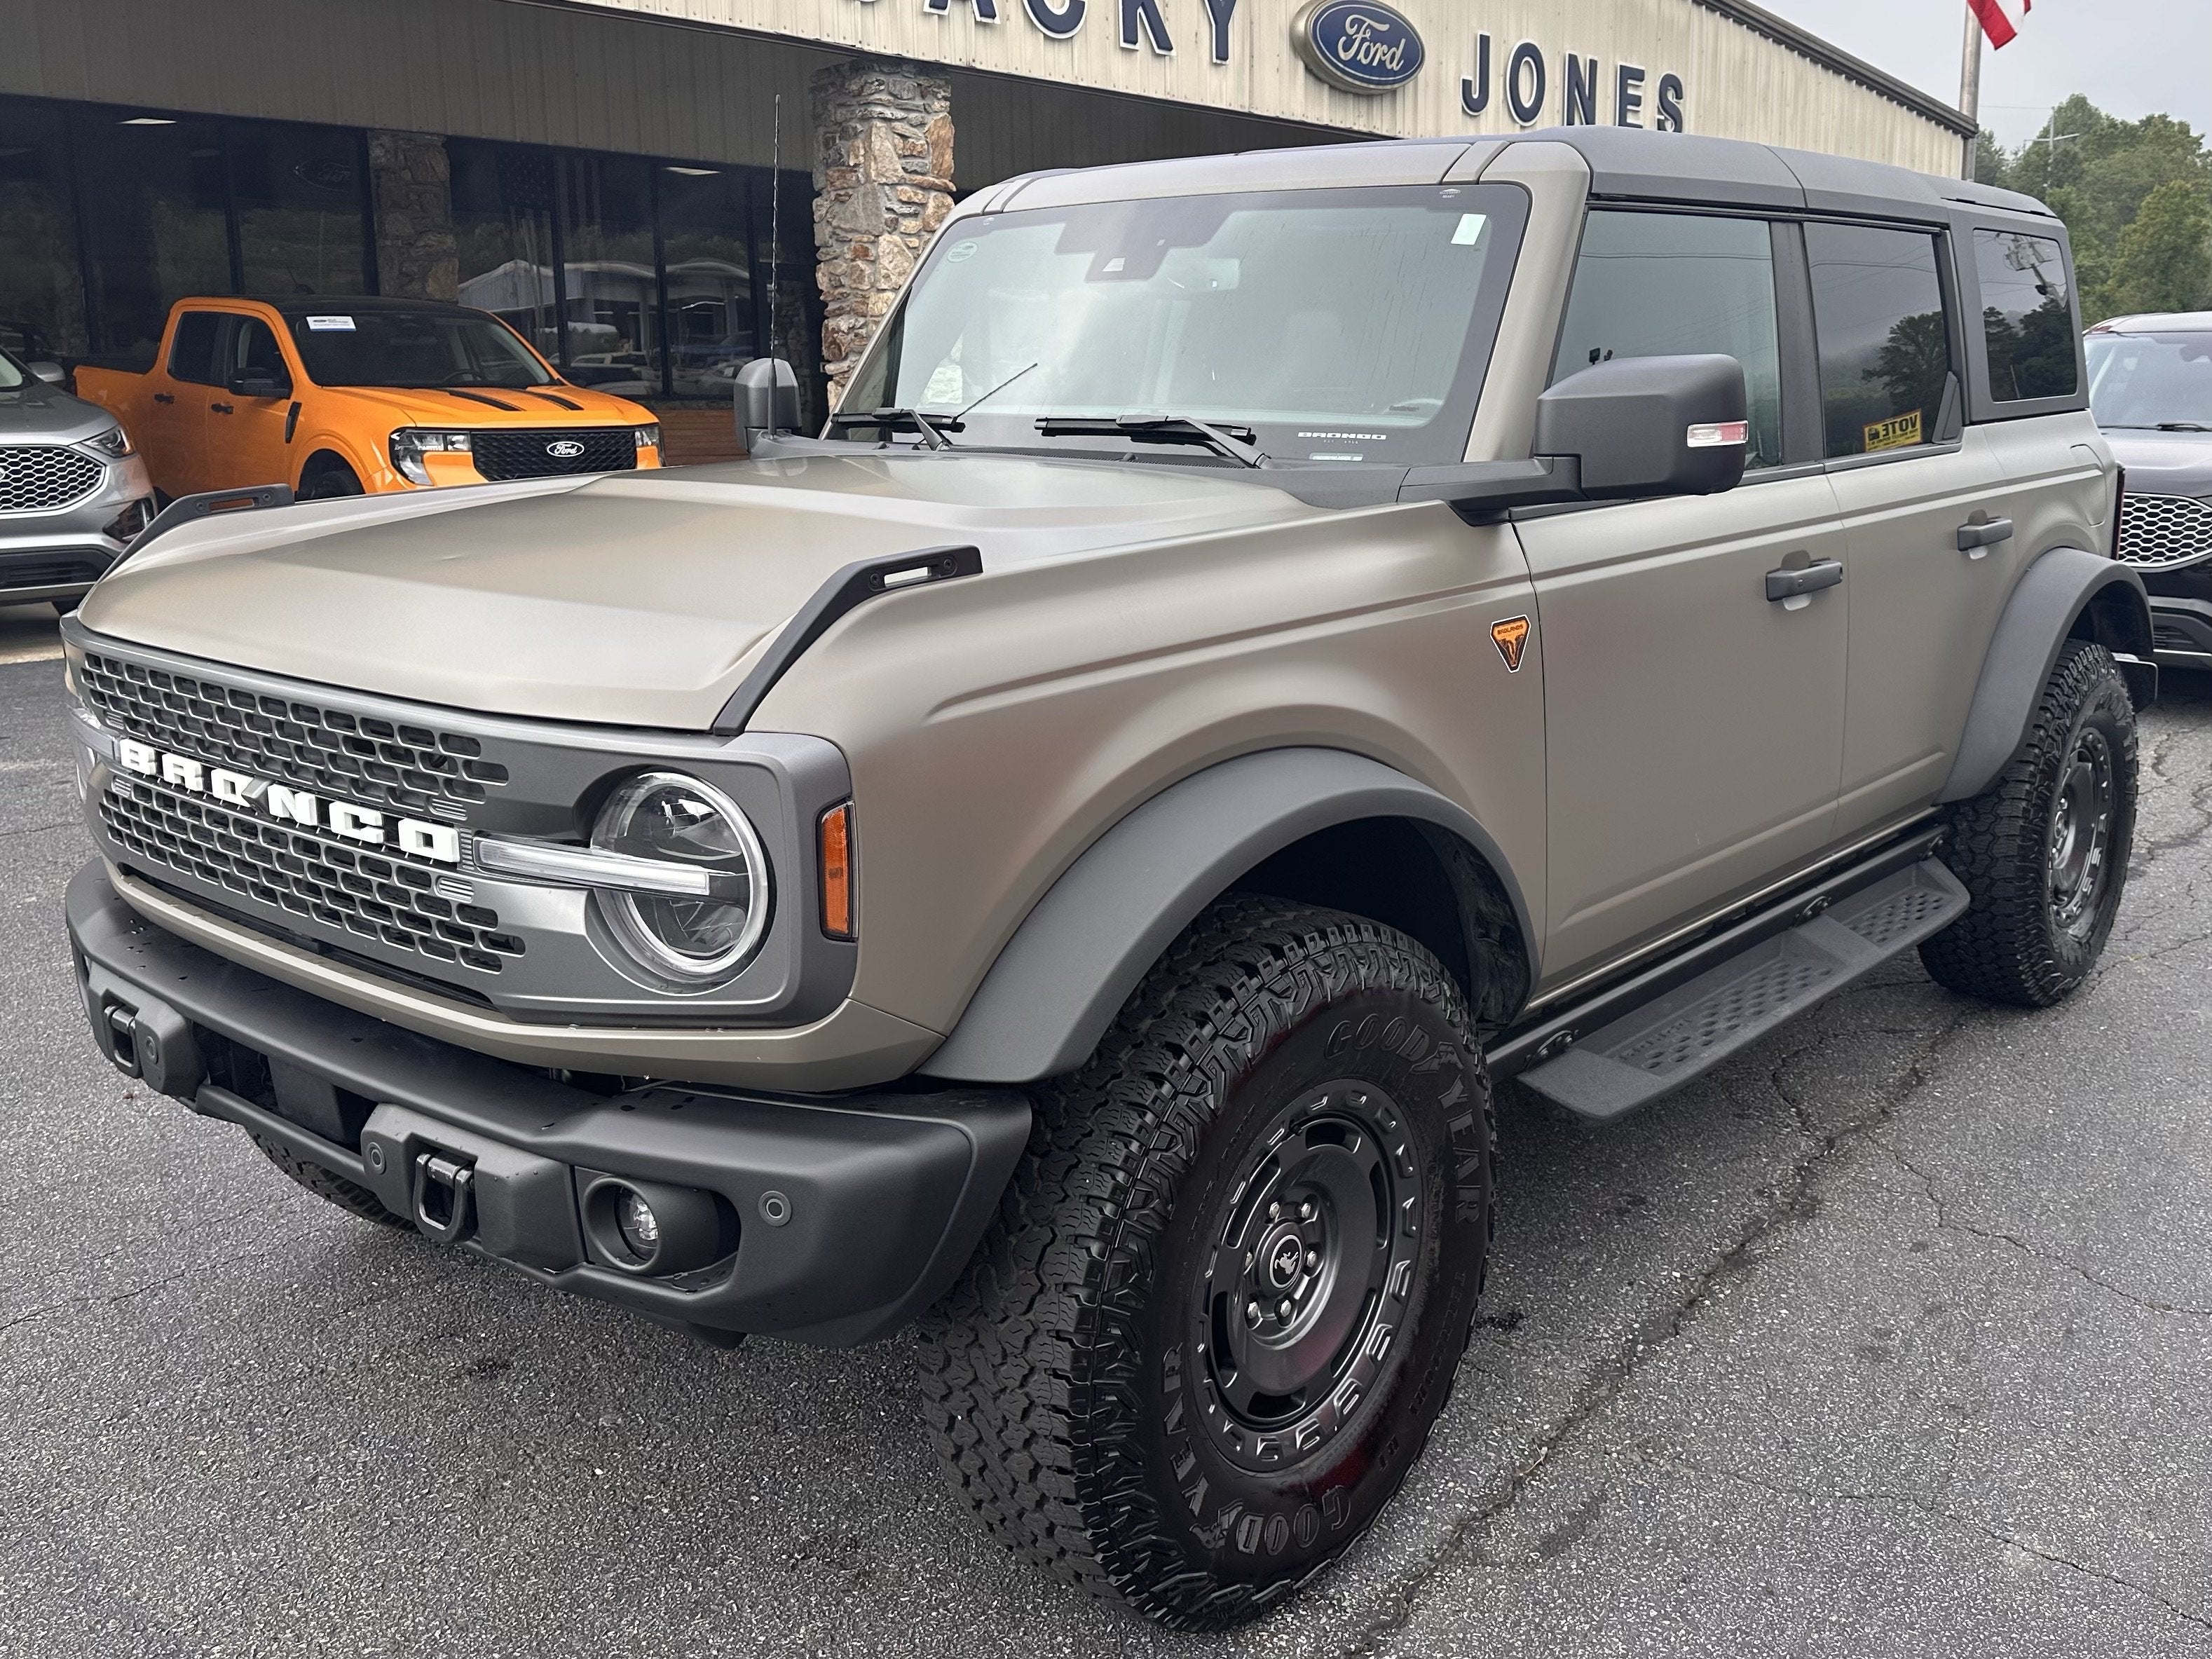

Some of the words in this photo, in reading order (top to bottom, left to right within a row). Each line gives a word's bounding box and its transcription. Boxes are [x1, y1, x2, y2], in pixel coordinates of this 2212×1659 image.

[1338, 14, 1405, 71] Ford
[1461, 32, 1684, 132] JONES
[554, 444, 578, 454] Ford
[119, 738, 462, 863] BRONCO
